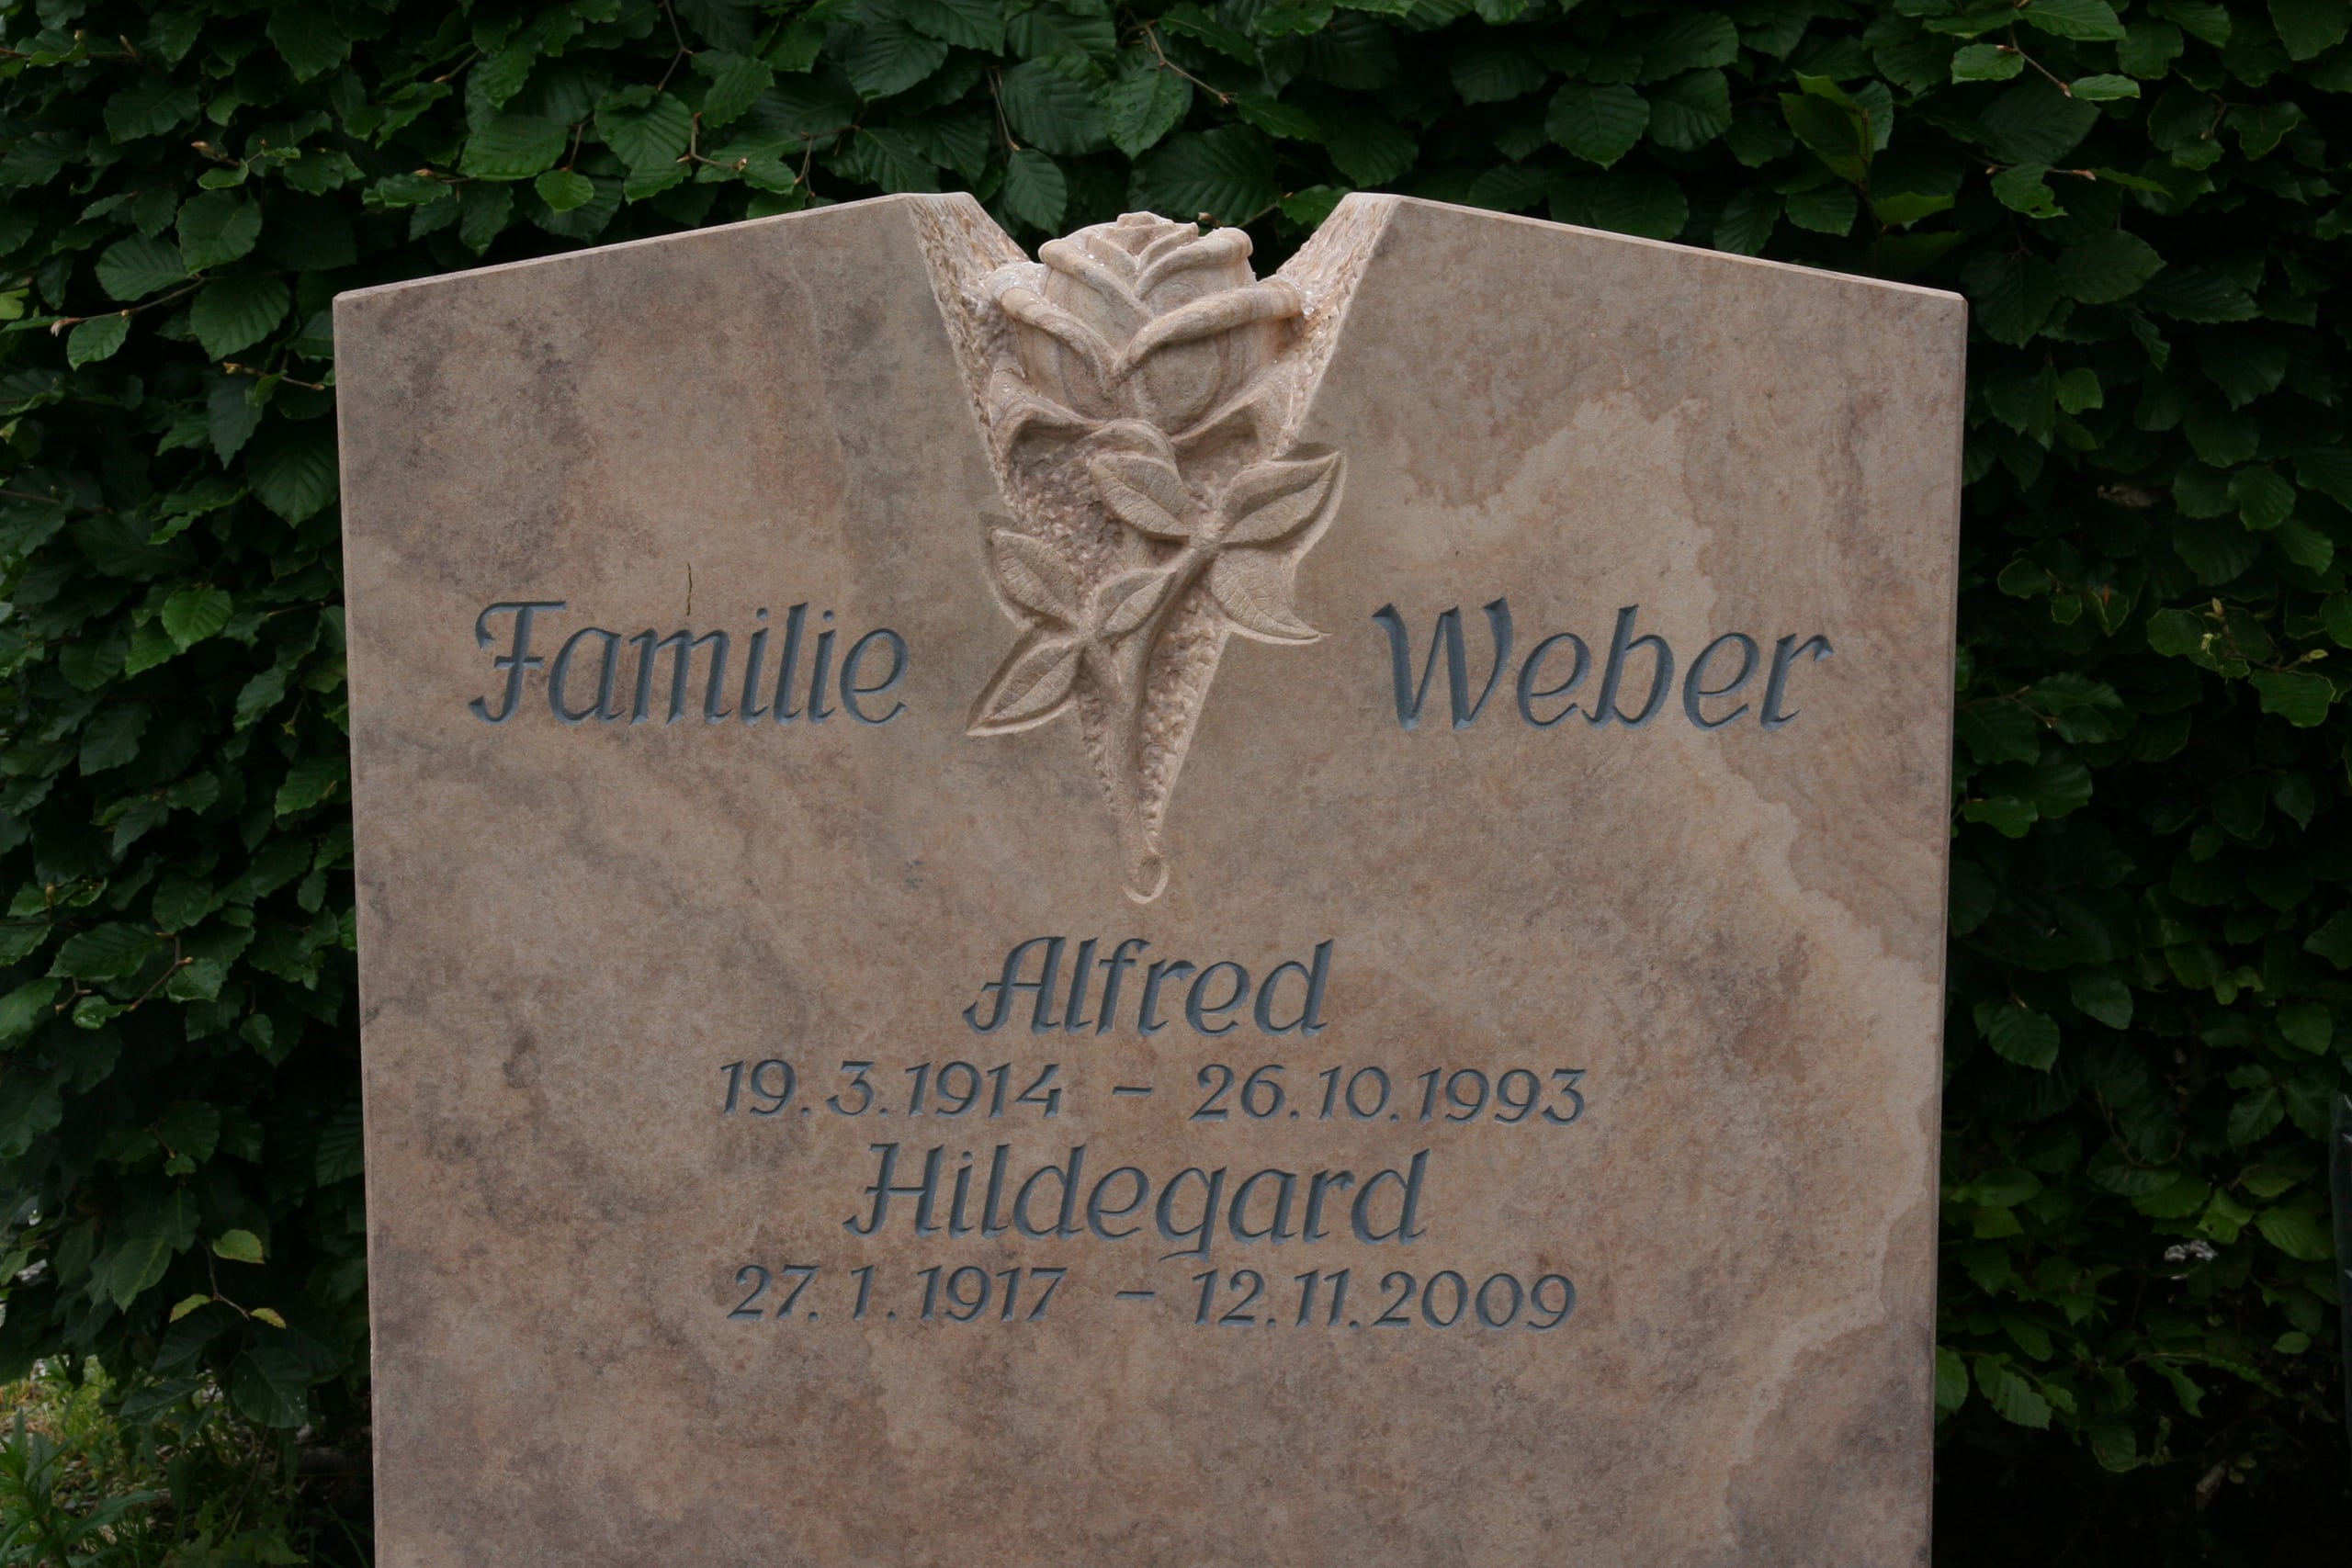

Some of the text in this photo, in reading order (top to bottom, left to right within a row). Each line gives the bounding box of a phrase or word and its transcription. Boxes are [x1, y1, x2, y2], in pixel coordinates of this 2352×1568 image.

[469, 596, 1835, 731] Familie Weber
[963, 936, 1334, 1037] Alfred
[1189, 1064, 1587, 1125] 26.10.1993
[842, 1142, 1430, 1262] Hildegard
[1191, 1268, 1577, 1330] 12.11.2009
